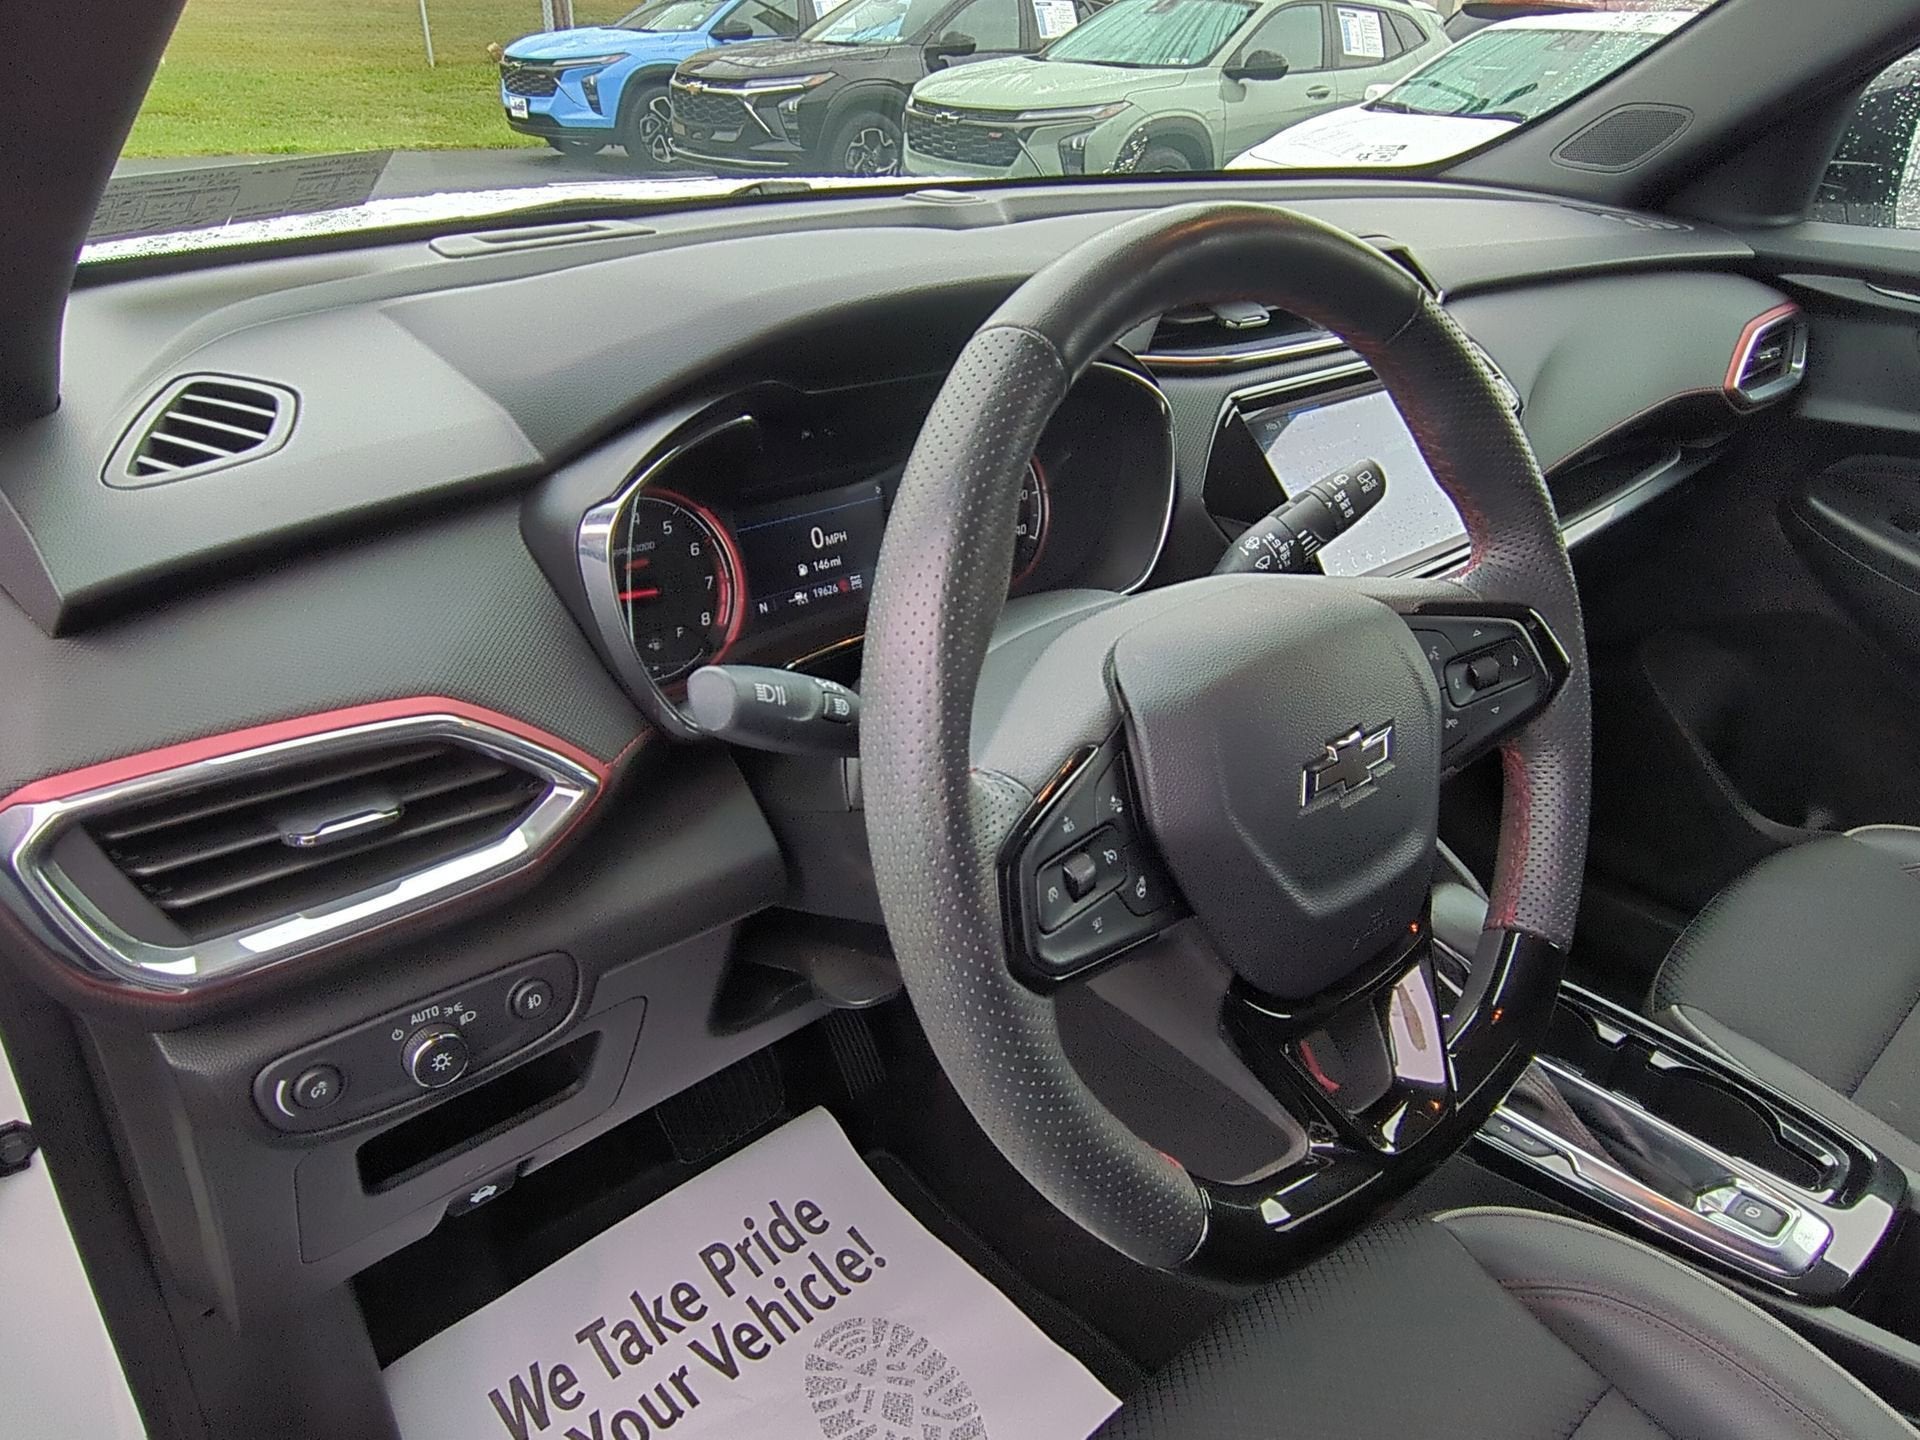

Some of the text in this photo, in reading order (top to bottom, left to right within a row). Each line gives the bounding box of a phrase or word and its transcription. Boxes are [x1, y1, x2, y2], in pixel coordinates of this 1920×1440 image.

[1361, 479, 1378, 494] REAR
[1334, 490, 1346, 502] OFF
[662, 520, 673, 535] 5
[810, 526, 848, 549] 0 MPH
[689, 542, 700, 556] 6
[704, 575, 714, 590] 7
[758, 601, 769, 614] N
[701, 611, 711, 626] 8
[676, 626, 684, 638] F
[410, 1005, 440, 1026] AUTO
[487, 1199, 831, 1440] We Take Pride
[563, 1225, 888, 1440] Your Vehicle!
